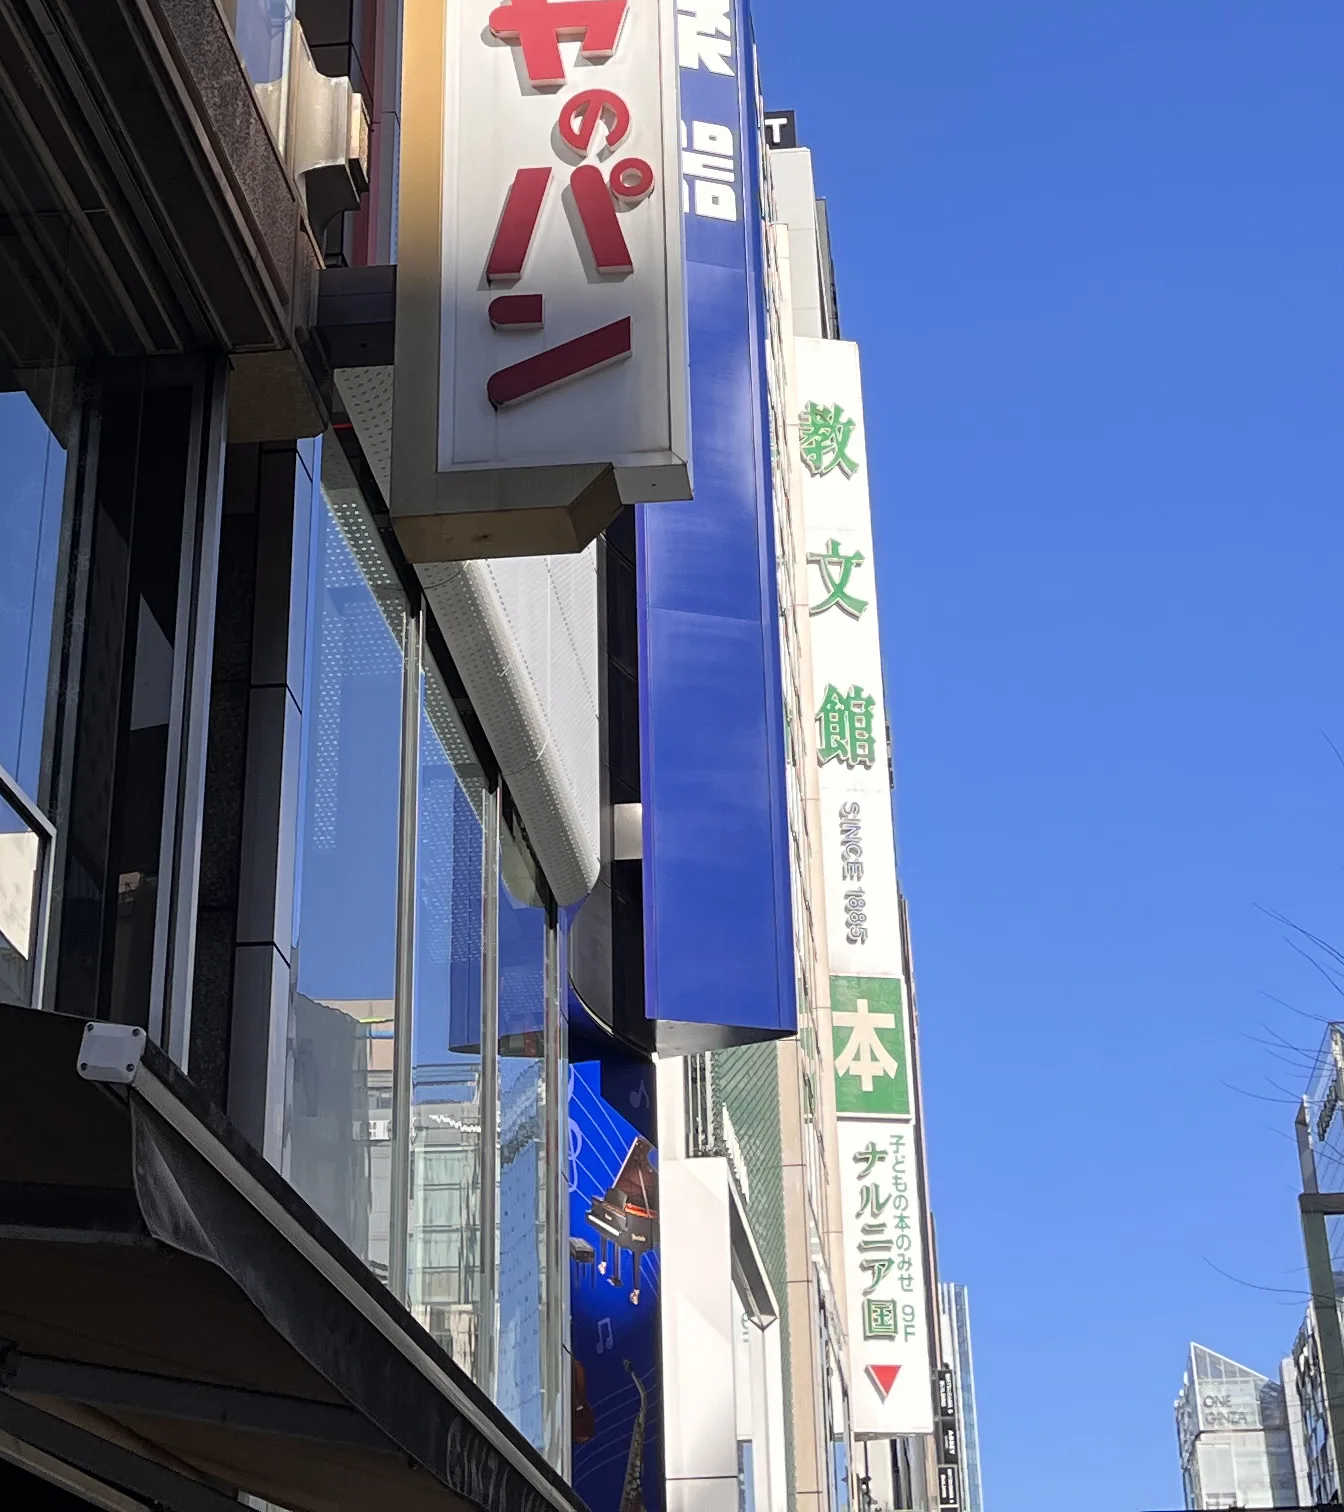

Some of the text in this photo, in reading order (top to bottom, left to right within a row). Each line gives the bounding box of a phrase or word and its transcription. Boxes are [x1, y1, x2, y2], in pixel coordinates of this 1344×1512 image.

[798, 399, 877, 770] 教文館
[839, 800, 868, 945] SINCE 1885
[832, 998, 898, 1092] 本
[852, 1140, 898, 1341] ナルニア国
[889, 1134, 916, 1343] 子どもの本のみせ 9F
[1204, 1394, 1232, 1409] ONE
[1206, 1411, 1248, 1426] GINZA
